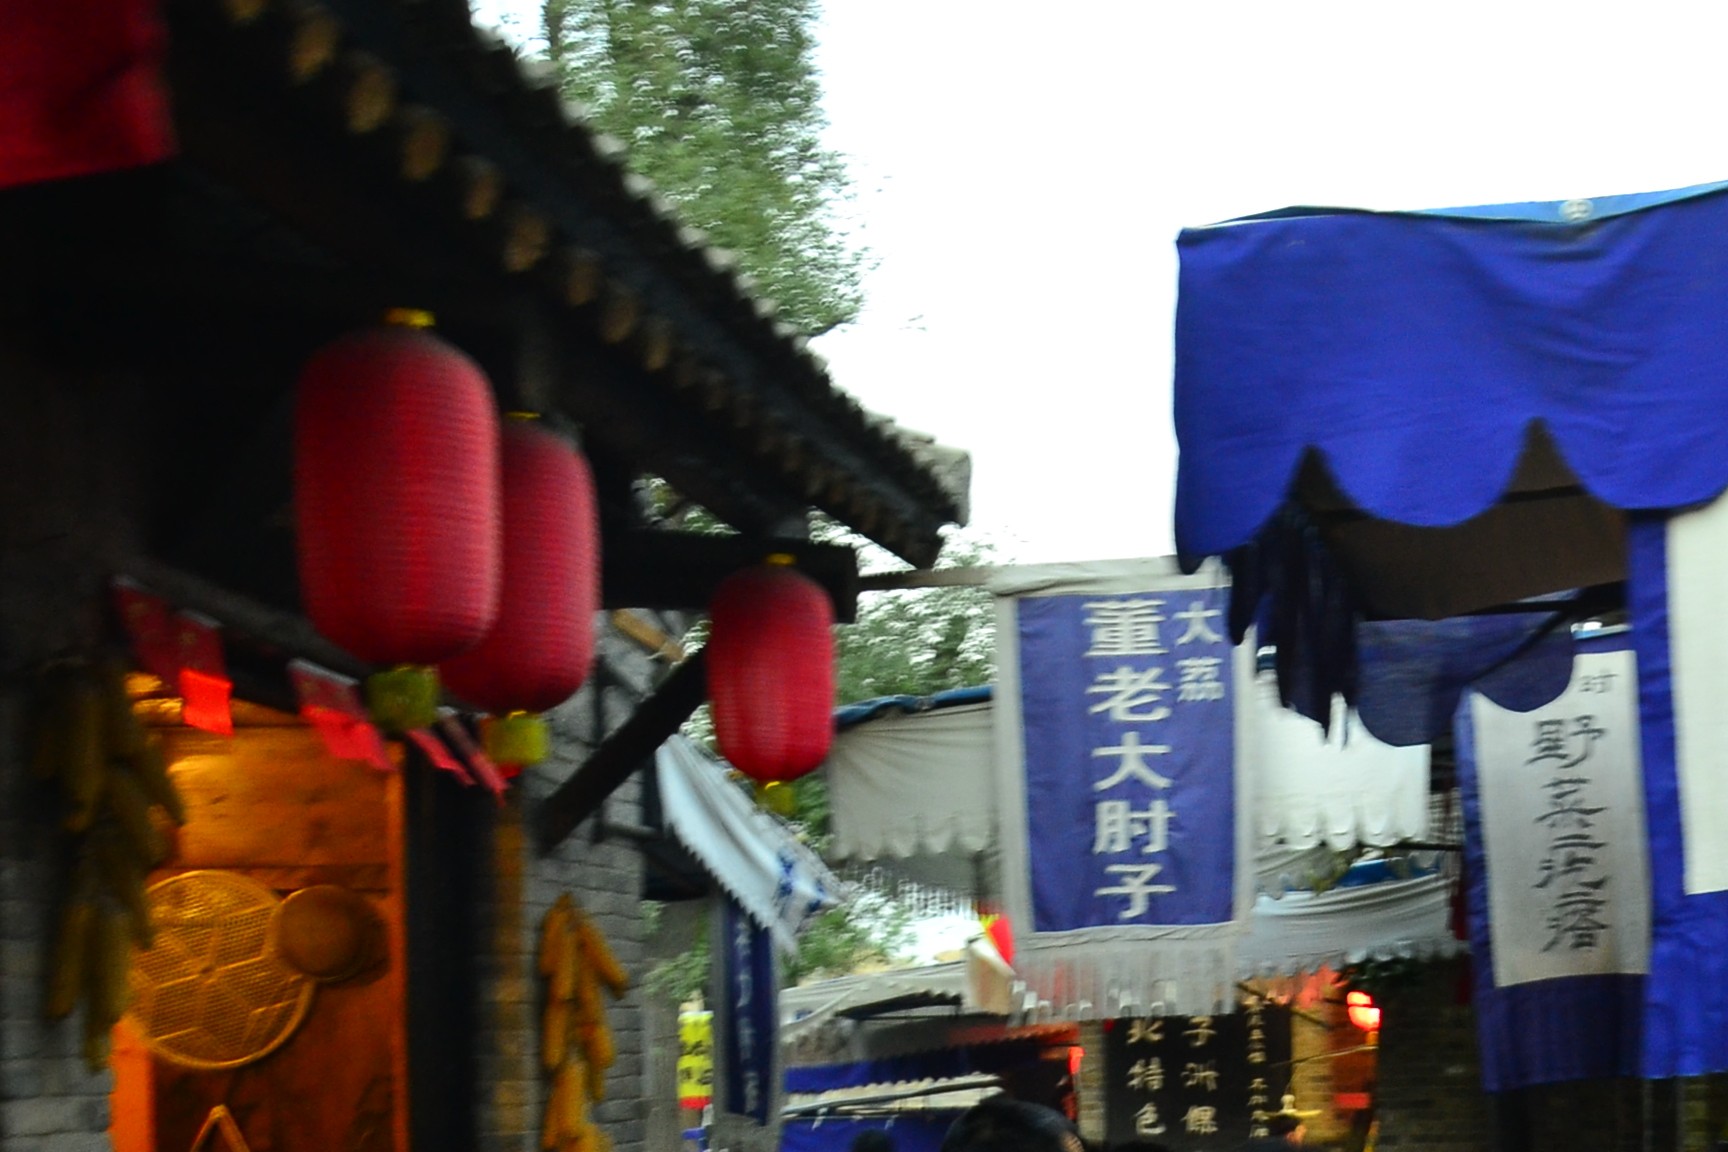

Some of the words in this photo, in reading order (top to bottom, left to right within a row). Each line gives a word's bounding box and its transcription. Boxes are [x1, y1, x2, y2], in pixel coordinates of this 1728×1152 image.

[1081, 598, 1176, 920] 董老大肘子
[1174, 600, 1224, 702] 大荔
[1523, 713, 1609, 953] 野菜疙瘩
